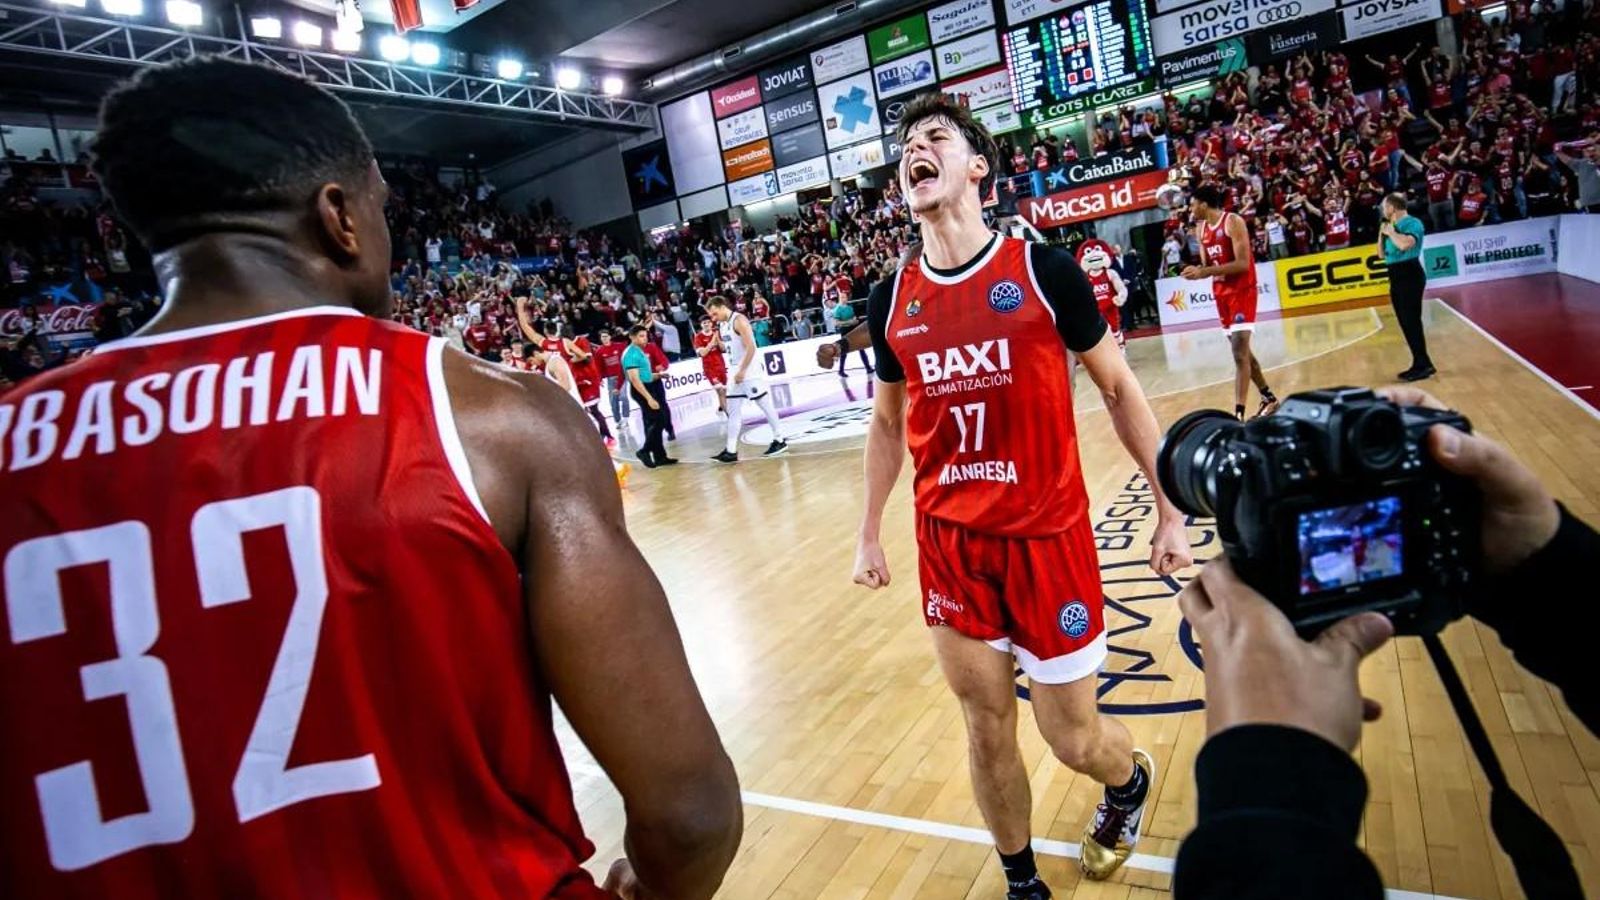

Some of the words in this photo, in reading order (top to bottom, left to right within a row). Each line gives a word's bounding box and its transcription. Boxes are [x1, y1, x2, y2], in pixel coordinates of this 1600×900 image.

[1180, 0, 1284, 29] moven
[1183, 16, 1250, 46] sarsa
[1162, 47, 1237, 75] Pavimentus
[764, 65, 806, 91] JOVIAT
[769, 100, 814, 124] sensus
[1048, 97, 1084, 117] COTS
[1092, 81, 1145, 105] CLARET
[1069, 151, 1154, 183] CaixaBank
[1030, 192, 1106, 225] Macsa
[1109, 180, 1133, 209] id
[1462, 238, 1483, 253] YOU
[1484, 235, 1507, 250] SHIP
[1286, 255, 1389, 292] GCS
[1432, 256, 1451, 271] J2
[1464, 252, 1483, 266] WE
[916, 338, 1011, 384] BAXI
[925, 372, 1013, 397] CLIMATIZACIÓN
[949, 402, 986, 453] 17
[938, 460, 1018, 486] MANRESA
[4, 486, 382, 871] 32
